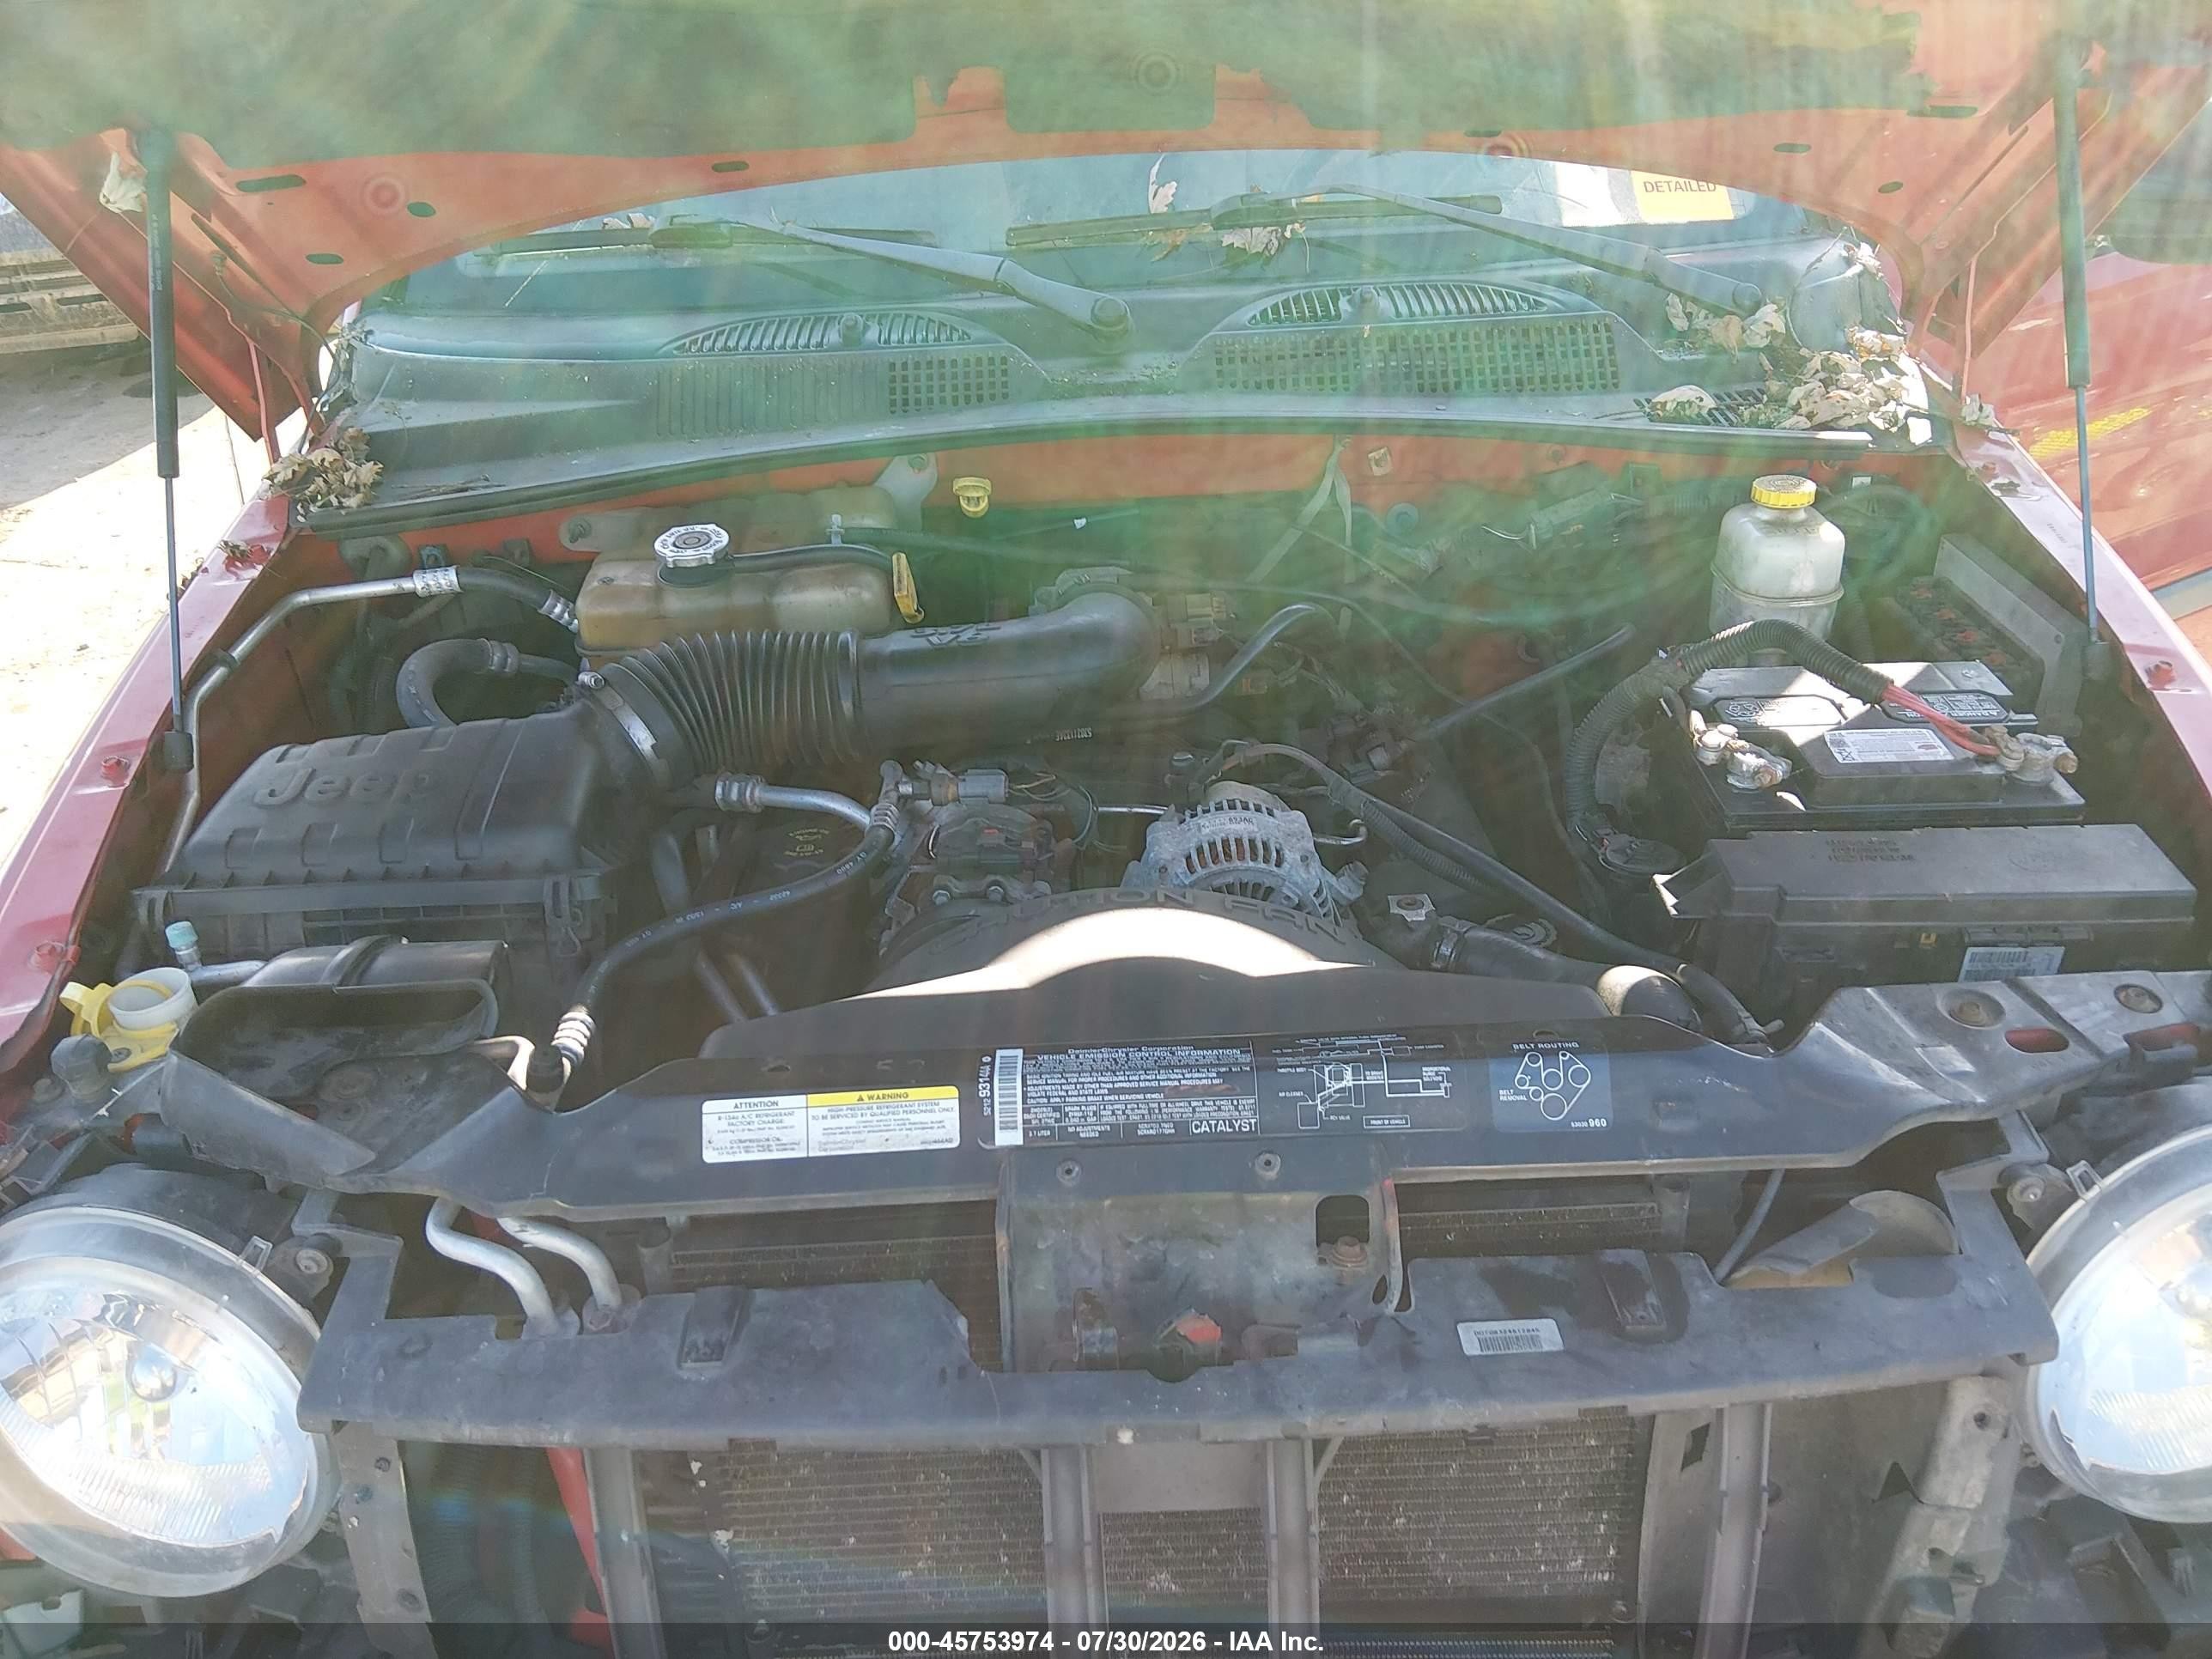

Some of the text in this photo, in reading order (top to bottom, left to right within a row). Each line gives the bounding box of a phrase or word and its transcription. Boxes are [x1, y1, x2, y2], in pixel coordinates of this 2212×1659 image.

[1643, 180, 1717, 193] DETAILED
[252, 767, 430, 809] Jeep
[1224, 897, 1347, 945] FAN
[867, 1091, 909, 1101] WARNING
[733, 1100, 780, 1109] ATTENTION
[876, 1102, 916, 1110] REFRIGERANT
[870, 1109, 901, 1117] QUALIFIED
[902, 1106, 937, 1115] PERSONNEL
[1191, 1119, 1257, 1133] CATALYST
